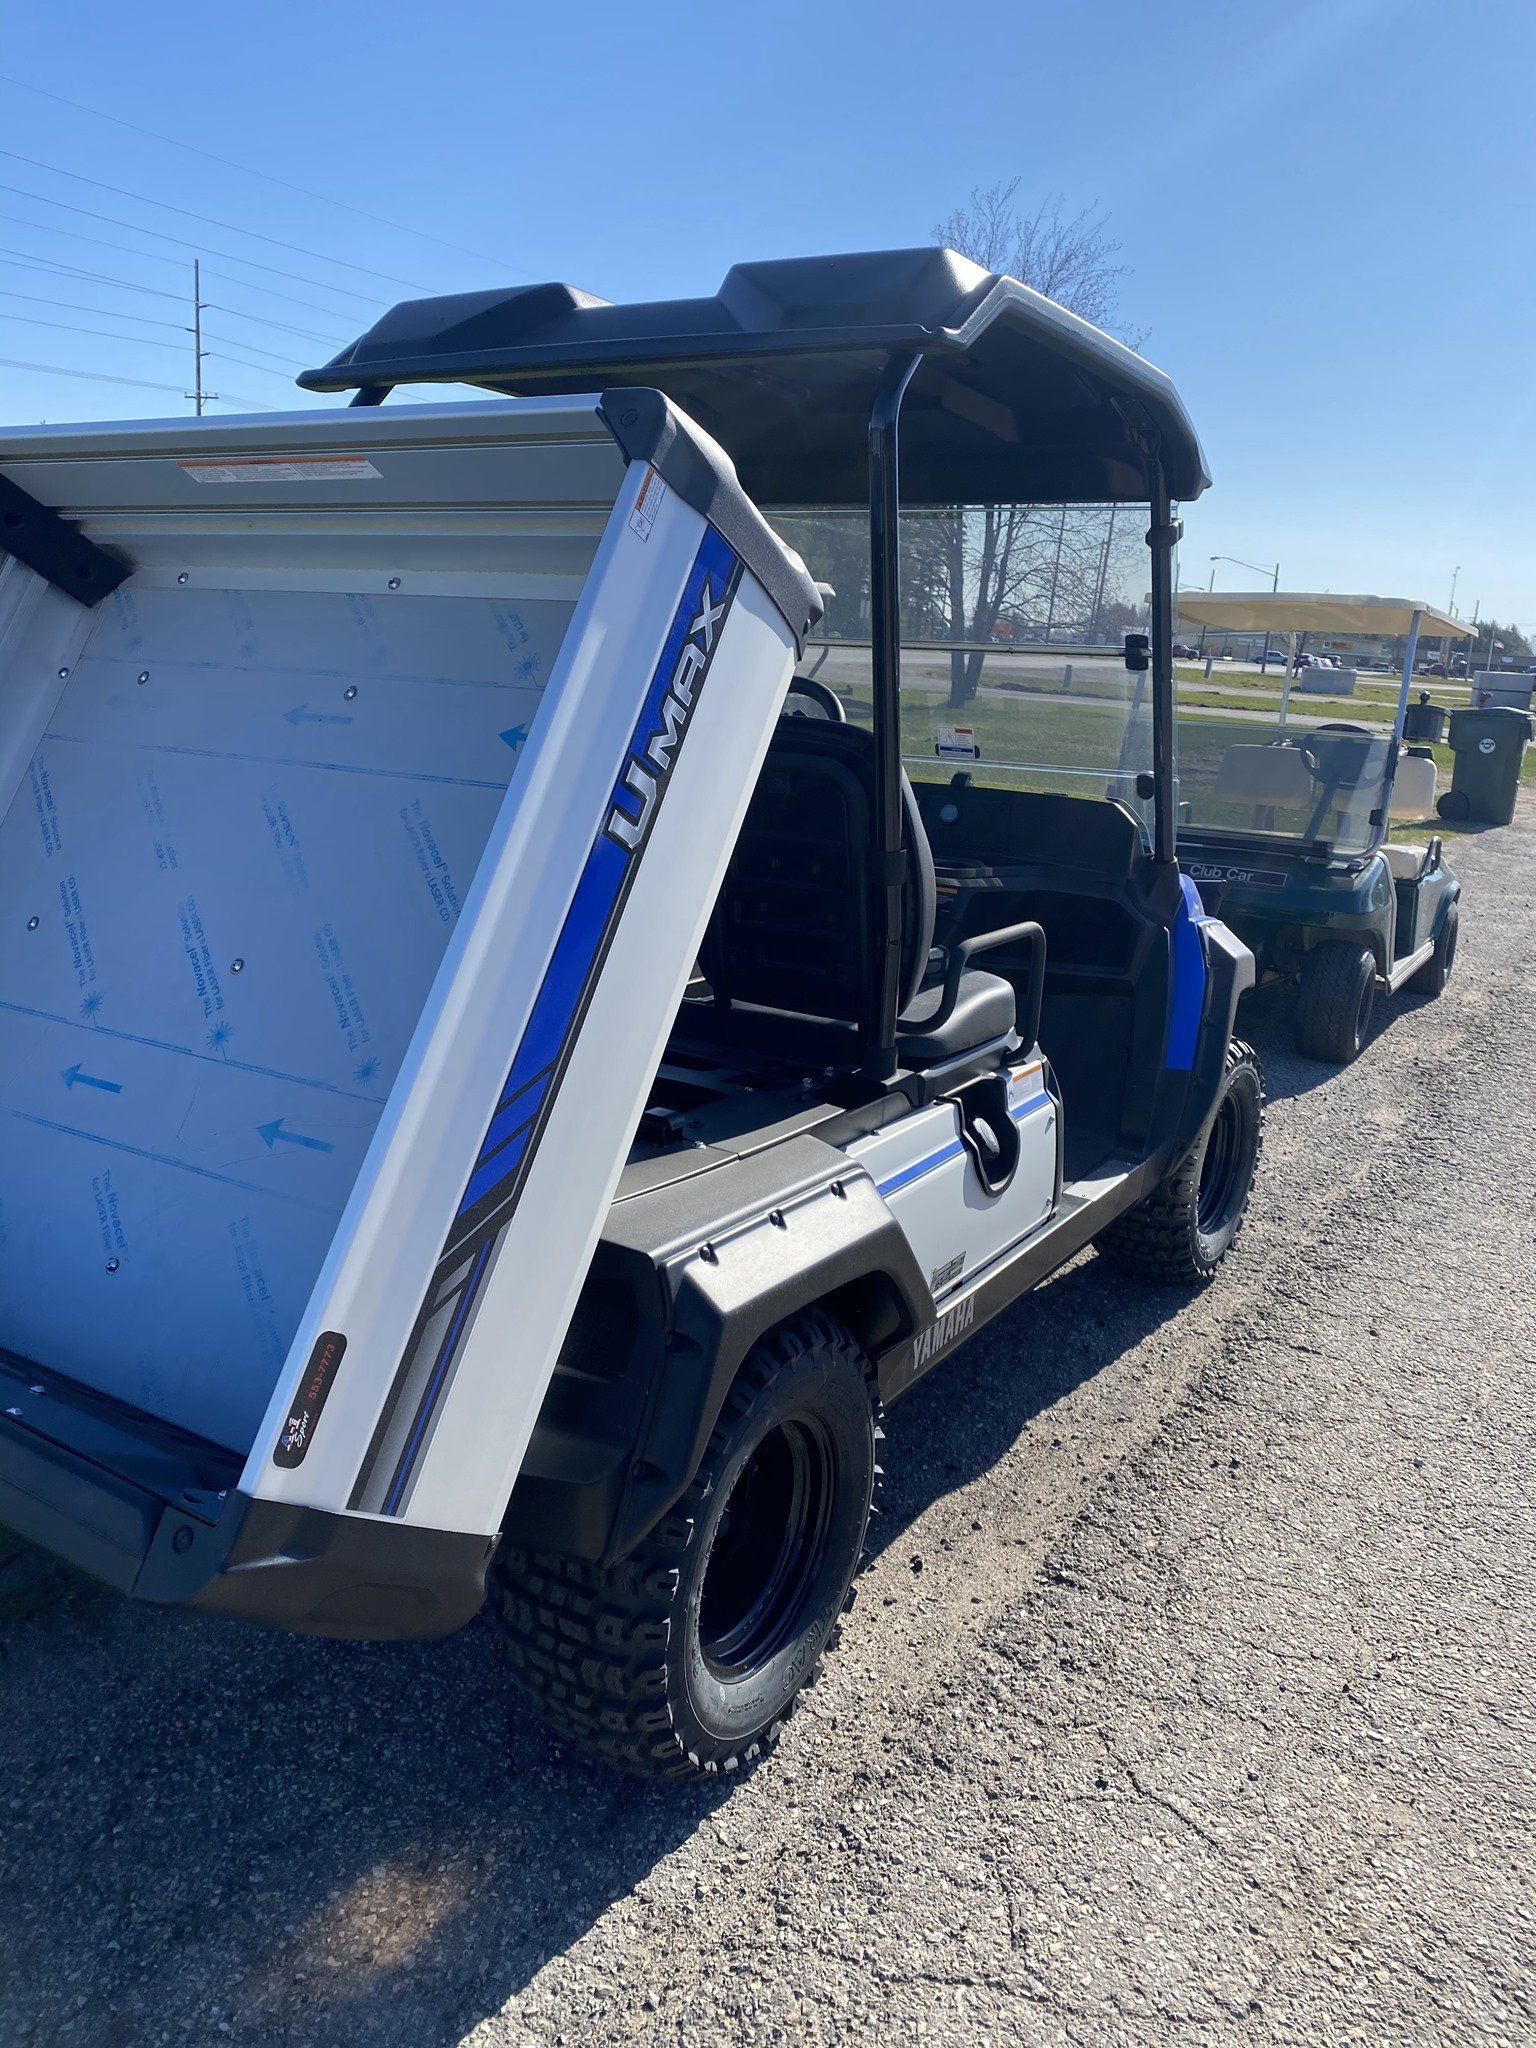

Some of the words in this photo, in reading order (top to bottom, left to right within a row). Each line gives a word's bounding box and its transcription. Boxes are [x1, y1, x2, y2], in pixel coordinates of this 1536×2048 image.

[607, 581, 726, 851] UMAX
[1189, 864, 1222, 878] Club
[1226, 868, 1254, 882] Car
[427, 877, 445, 909] LASER
[207, 967, 221, 997] LASER
[203, 998, 214, 1019] The
[912, 1293, 975, 1371] YAMAHA
[308, 1343, 336, 1400] 553-7773
[294, 1411, 310, 1449] Sport
